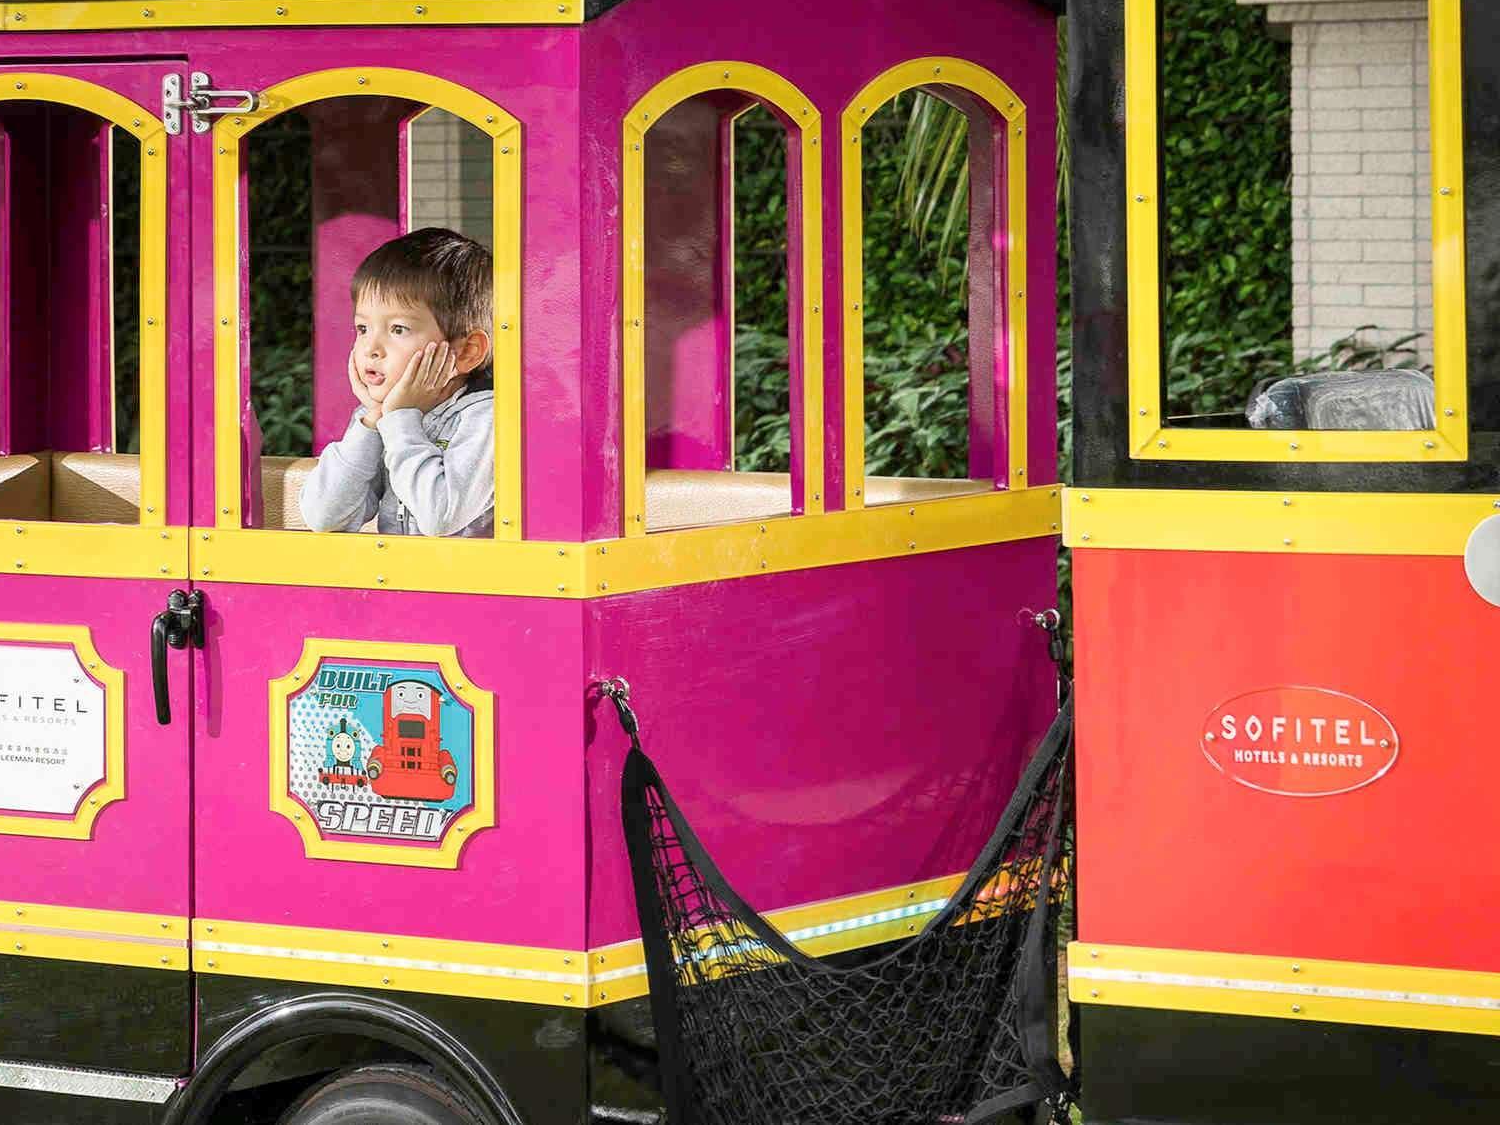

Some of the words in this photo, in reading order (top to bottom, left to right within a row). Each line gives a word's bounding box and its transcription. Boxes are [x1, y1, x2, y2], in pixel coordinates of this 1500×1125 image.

[319, 670, 393, 693] BUILT
[318, 691, 357, 709] FOR
[23, 715, 77, 726] RESORTS
[1221, 714, 1376, 746] SOFITEL
[0, 754, 35, 764] LEEMAN
[35, 757, 66, 766] RESORT
[1234, 749, 1286, 764] HOTELS
[1290, 752, 1298, 764] &
[1303, 752, 1364, 768] RESORTS
[318, 800, 447, 839] SPEED
